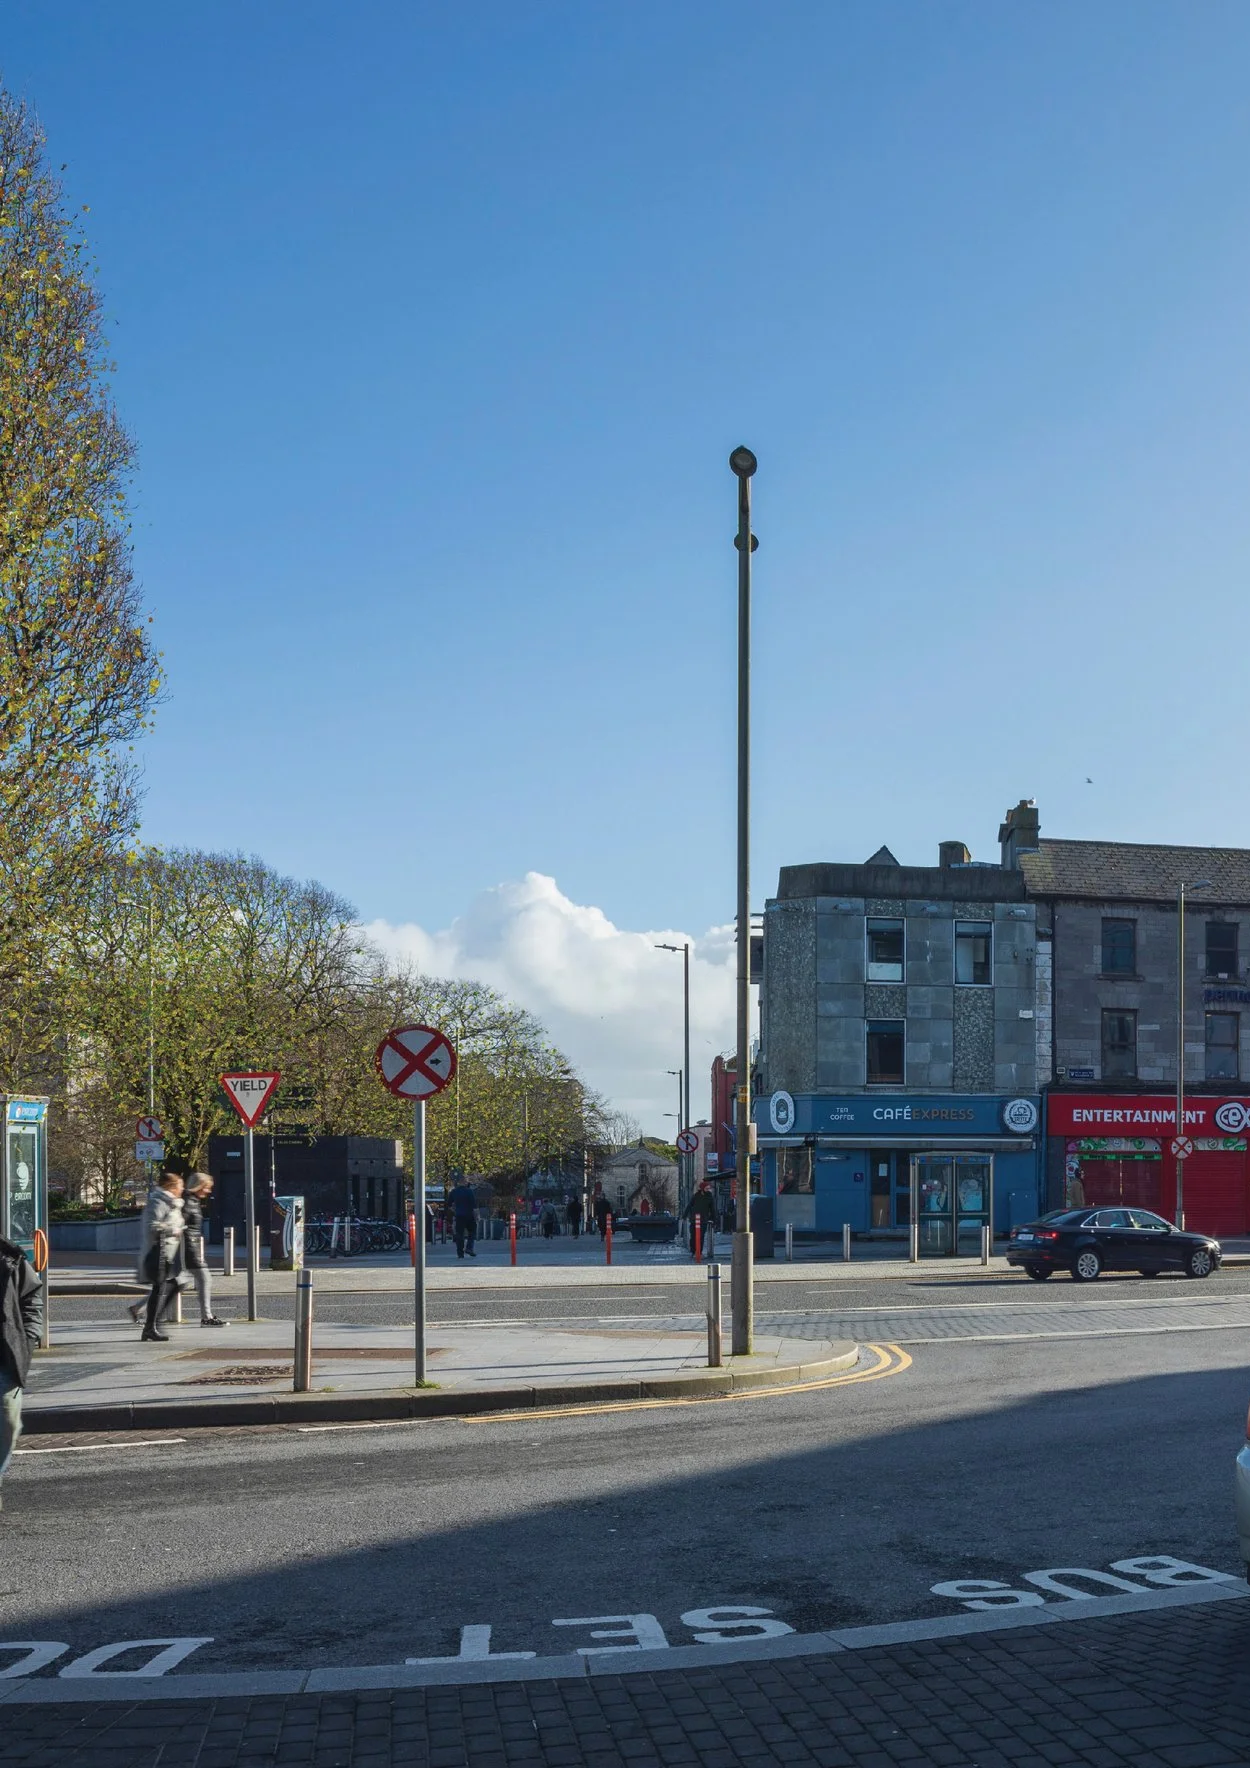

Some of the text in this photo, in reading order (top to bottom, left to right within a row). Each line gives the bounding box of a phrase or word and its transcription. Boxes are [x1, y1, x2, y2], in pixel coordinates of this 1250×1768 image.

[231, 1080, 267, 1091] YIELD
[930, 1555, 1248, 1610] BUS
[405, 1605, 796, 1665] SET
